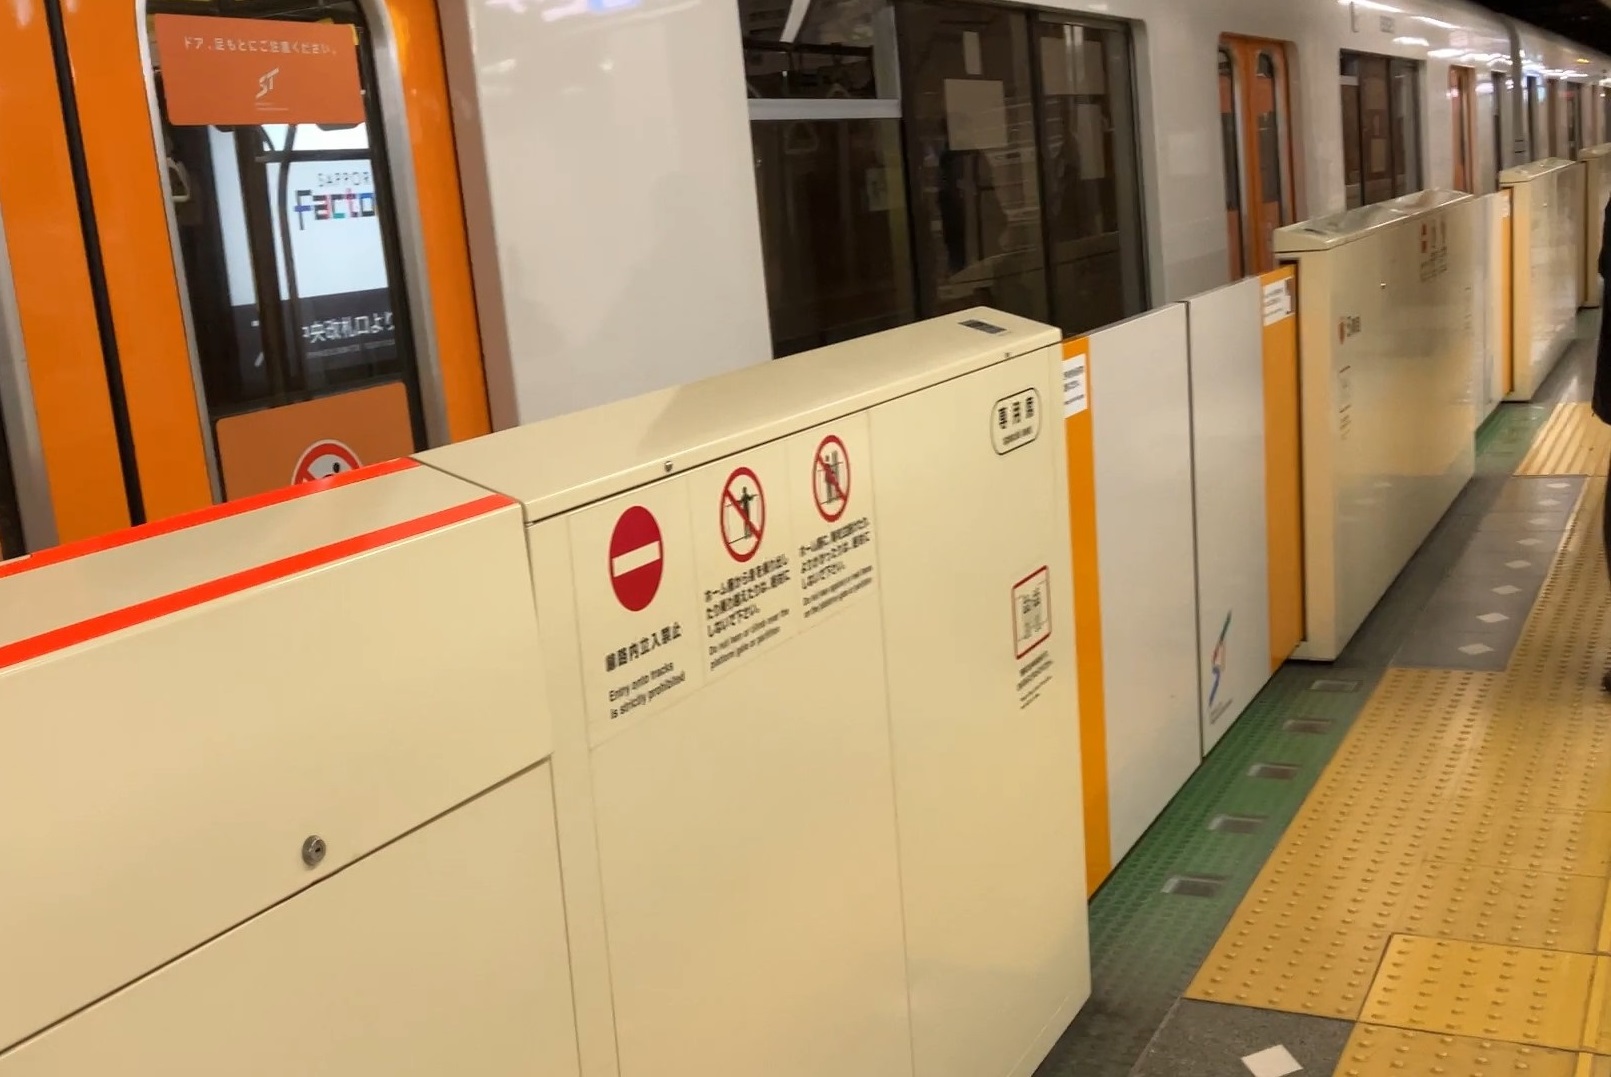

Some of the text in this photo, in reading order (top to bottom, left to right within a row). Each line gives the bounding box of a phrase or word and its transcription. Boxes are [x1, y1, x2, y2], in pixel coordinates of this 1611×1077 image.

[609, 662, 674, 702] Entry onto tracks
[610, 670, 685, 720] is strictly prohibited
